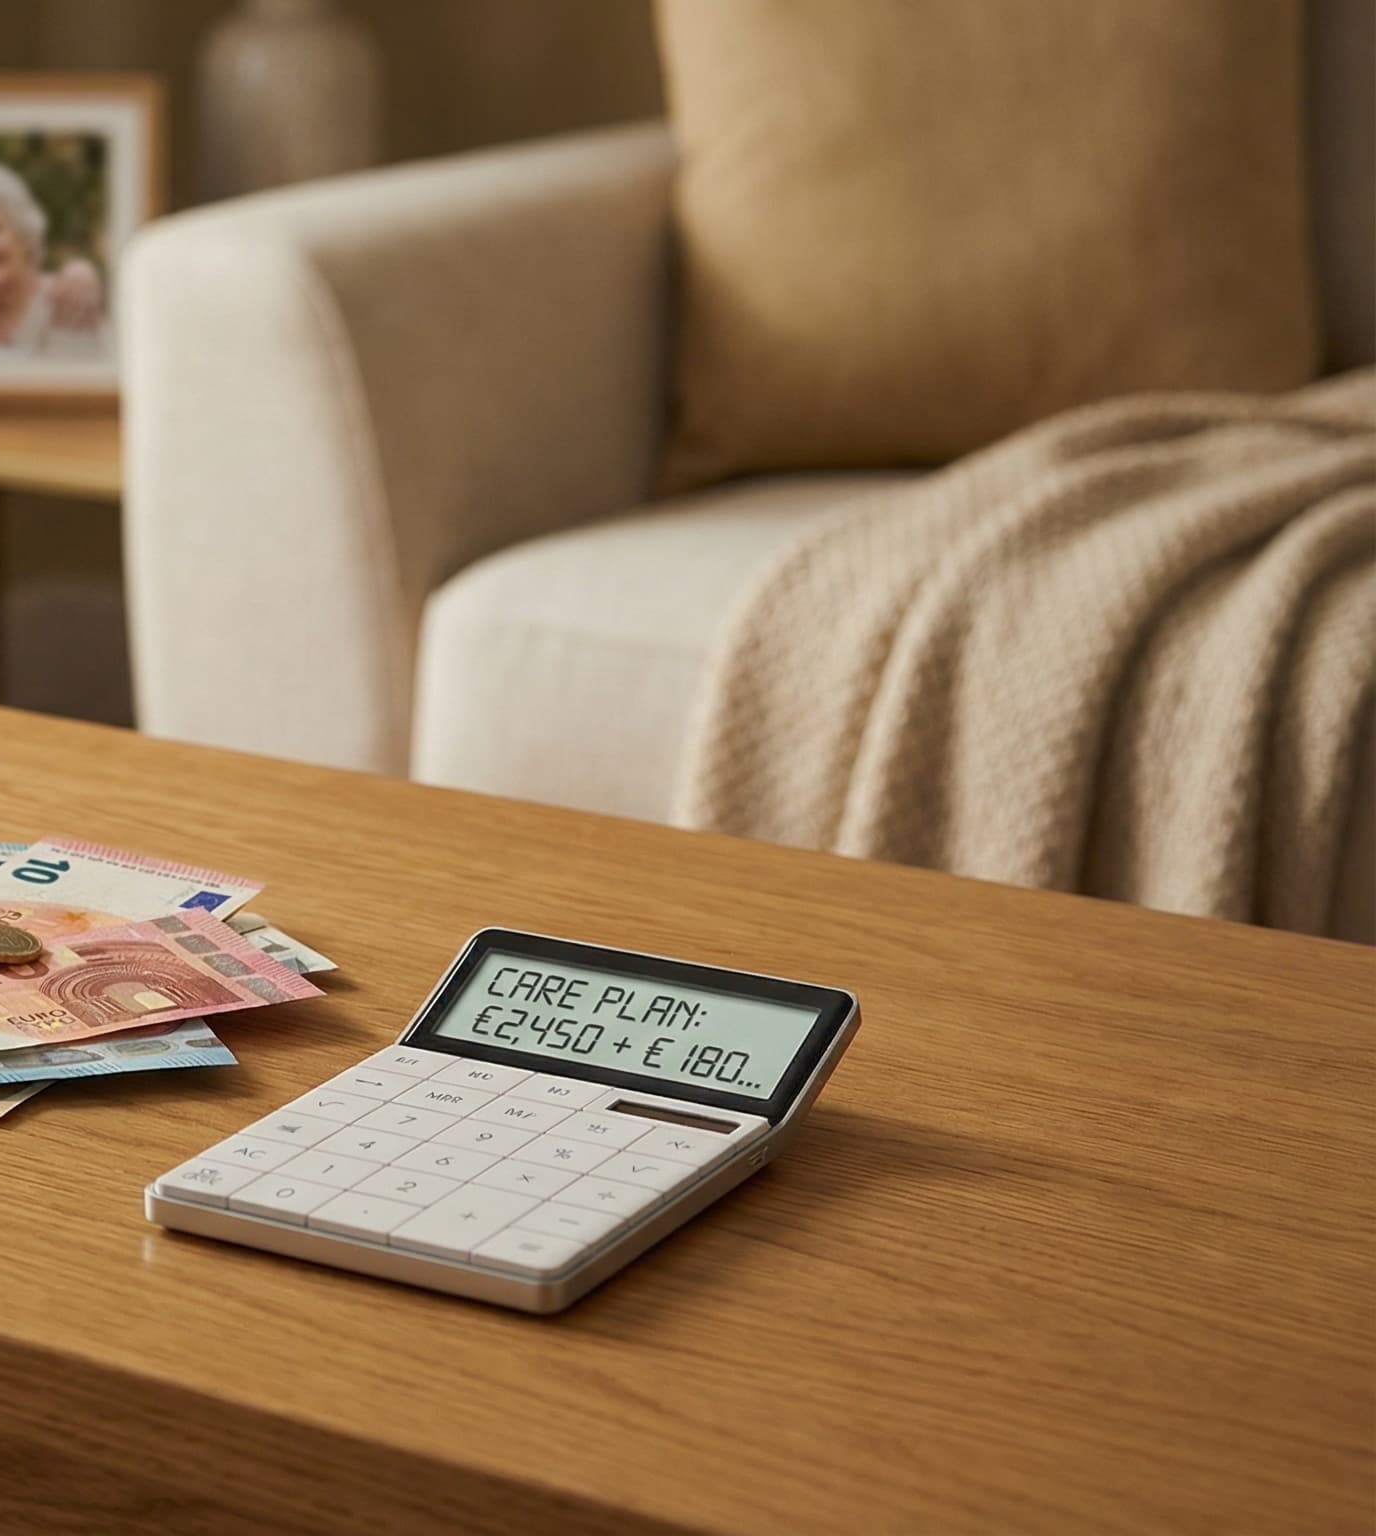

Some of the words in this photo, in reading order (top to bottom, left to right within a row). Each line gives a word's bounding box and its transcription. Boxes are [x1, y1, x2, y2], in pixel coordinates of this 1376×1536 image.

[12, 858, 71, 885] 10
[488, 967, 589, 1010] CARE
[592, 986, 708, 1031] PLAN:
[471, 1005, 605, 1054] €2,450
[613, 1036, 632, 1054] +
[397, 1115, 417, 1125] 7
[475, 1132, 493, 1142] 9
[232, 1147, 267, 1159] AC
[396, 1181, 418, 1193] 2
